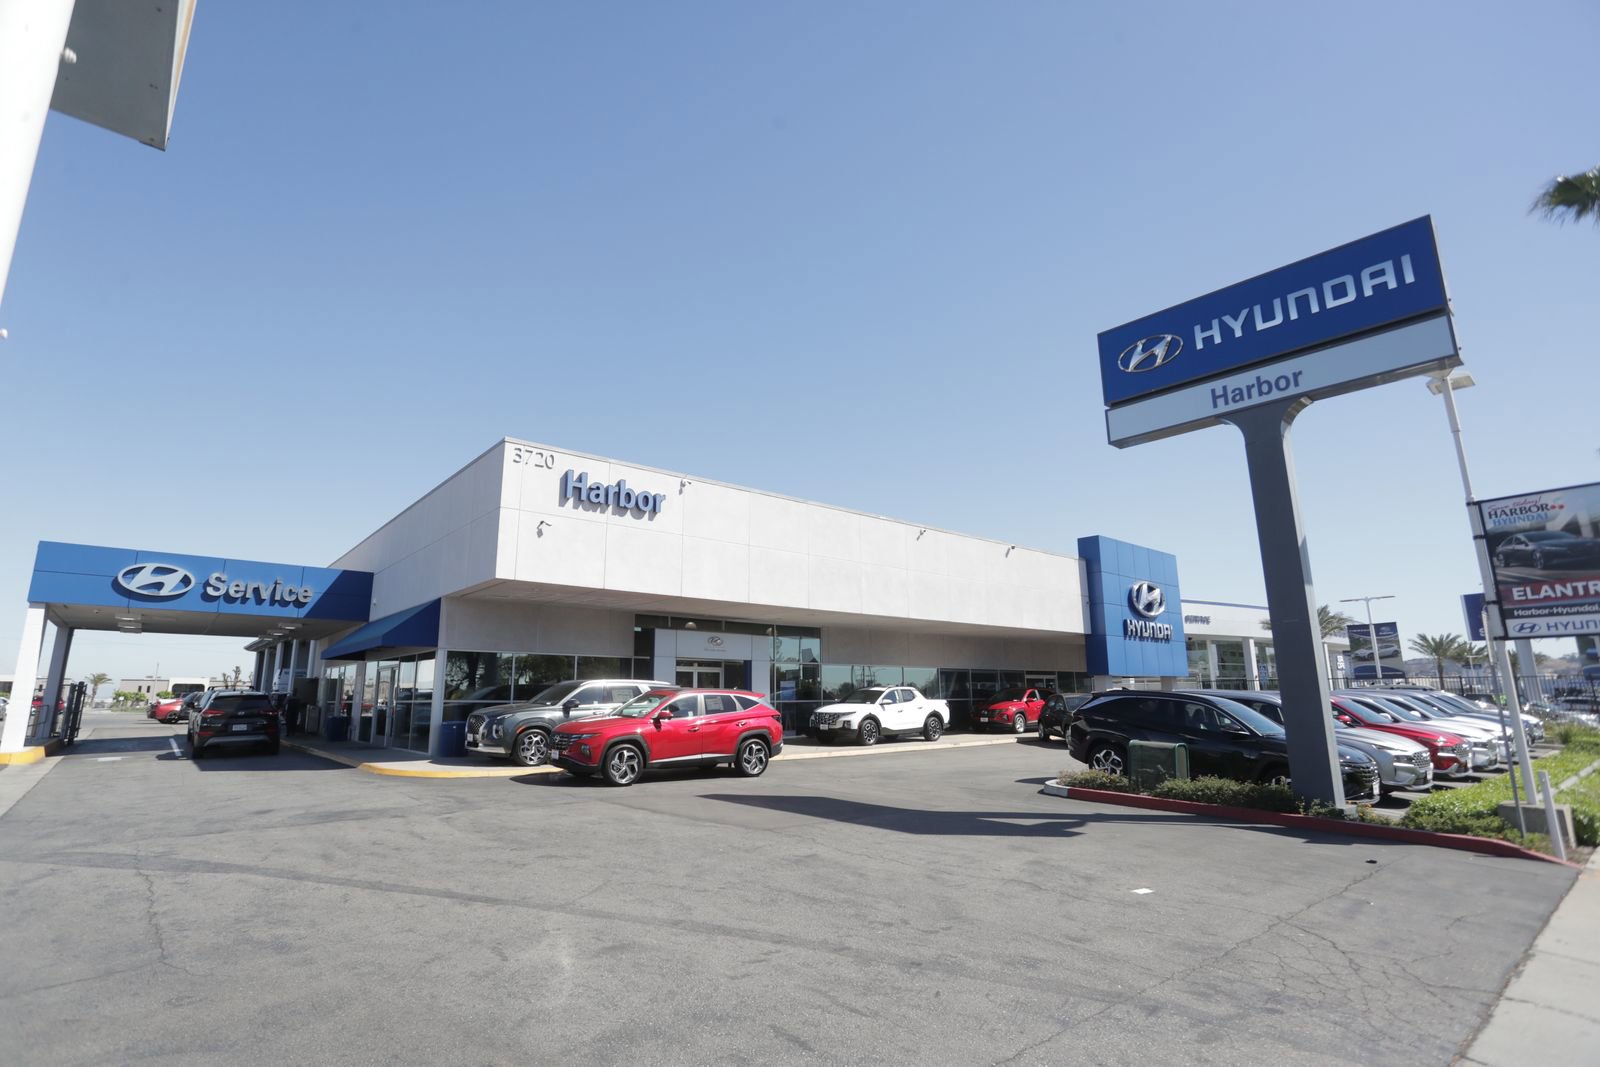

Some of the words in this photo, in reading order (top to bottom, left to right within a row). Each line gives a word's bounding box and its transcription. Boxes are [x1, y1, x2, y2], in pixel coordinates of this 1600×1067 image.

[1193, 253, 1416, 350] HYUNDAI
[1210, 370, 1304, 409] Harbor
[512, 447, 555, 470] 3720
[562, 469, 666, 513] Harbor
[1488, 504, 1551, 519] HARBOR
[1493, 512, 1549, 526] HYUNDAI
[206, 571, 313, 603] Service
[1127, 618, 1173, 639] HYUNDAI
[1546, 619, 1600, 632] HYUN
